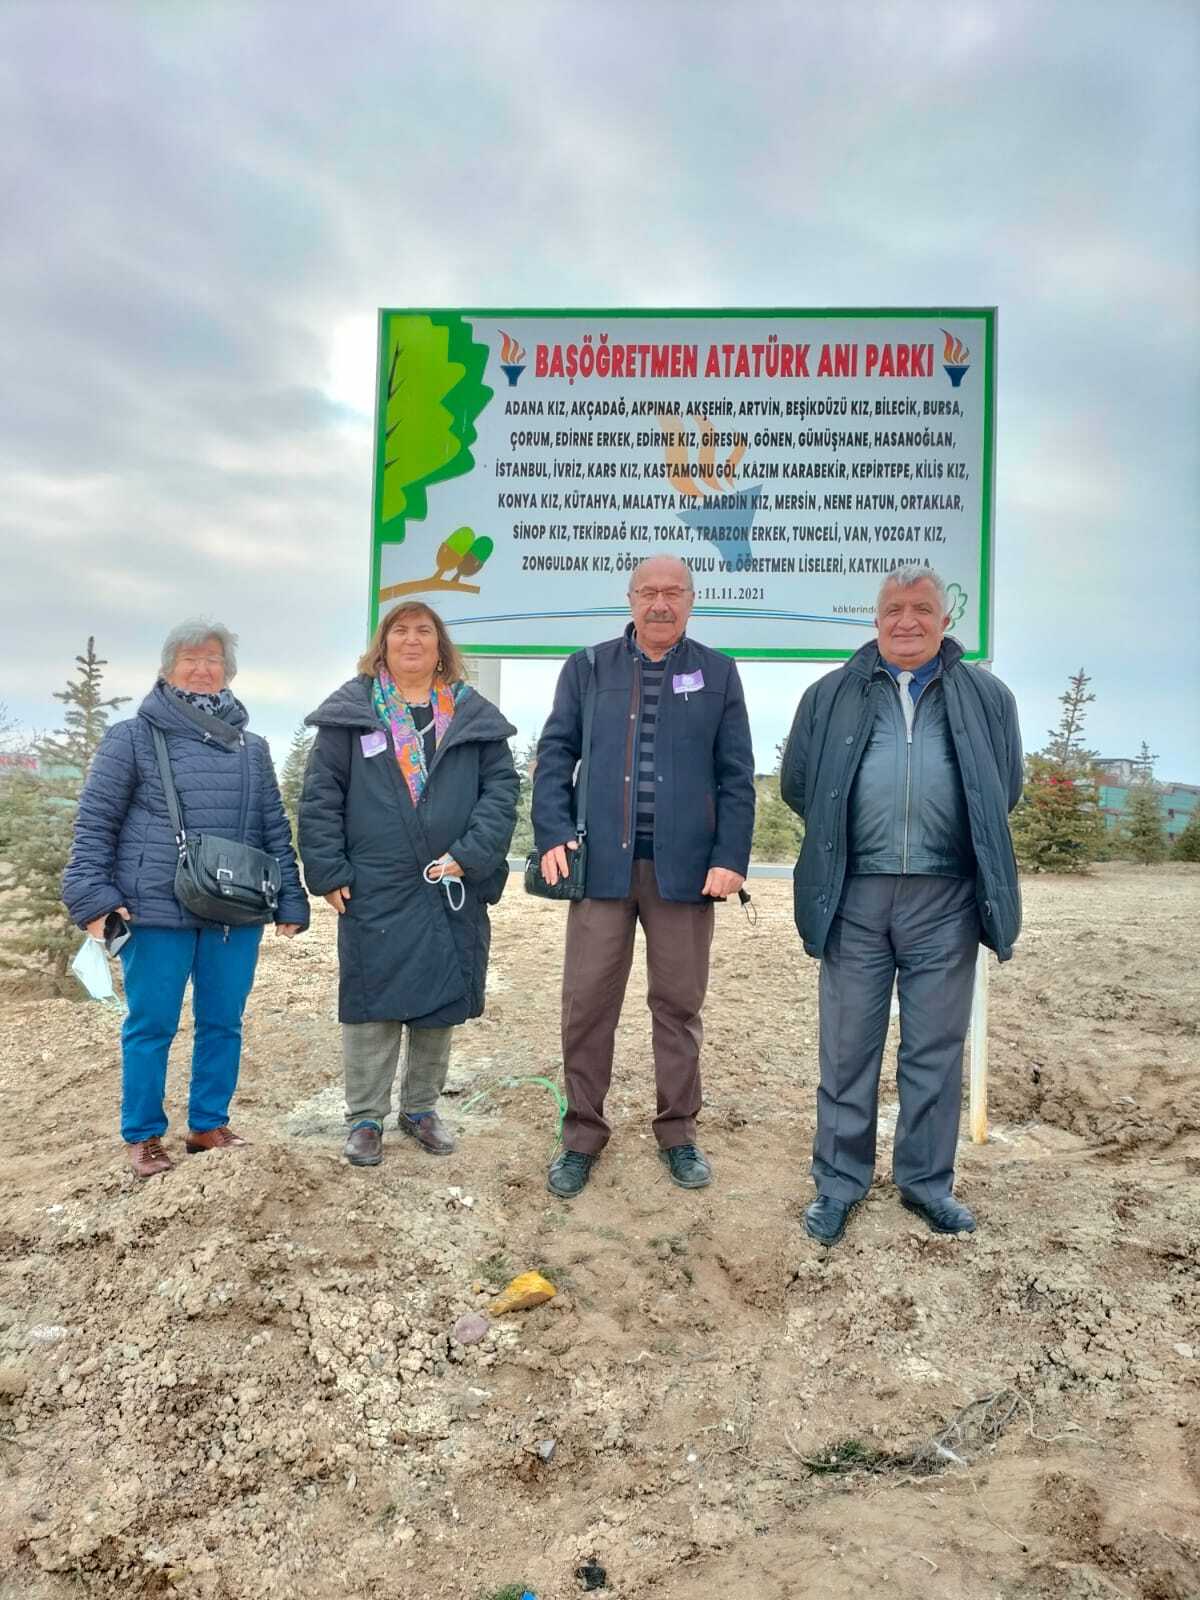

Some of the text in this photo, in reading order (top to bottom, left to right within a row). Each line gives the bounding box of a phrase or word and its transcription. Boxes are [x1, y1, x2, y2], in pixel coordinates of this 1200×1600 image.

[535, 333, 935, 386] BAŞÖĞRETMEN ATATÜRK ANI PARKI
[504, 396, 964, 421] ADANA KIZ, AKÇADAĞ, AKPINAR, AKŞEHİR, ARTVİN, BEŞİKDÜZÜ KIZ, BİLECİK, BURSA,
[510, 427, 957, 452] ÇORUM, EDİRNE ERKEK, EDİRNE KIZ, GİRESUN, GÖNEN, GÜMÜŞHANE, HASANOĞLAN,
[495, 458, 552, 480] İSTANBUL,
[553, 458, 586, 480] İVRİZ,
[587, 462, 617, 478] KARS
[619, 462, 642, 481] KIZ,
[643, 463, 714, 479] KASTAMONU
[715, 459, 741, 481] GÖL,
[782, 459, 850, 481] KARABEKİR,
[851, 459, 914, 481] KEPİRTEPE,
[915, 459, 944, 479] KİLİS
[946, 462, 970, 481] KIZ,
[497, 492, 538, 509] KONYA
[540, 492, 563, 511] KIZ,
[563, 490, 621, 511] KÜTAHYA,
[622, 494, 676, 510] MALATYA
[679, 494, 701, 511] KIZ,
[702, 490, 748, 510] MARDİN
[751, 494, 773, 512] KIZ,
[823, 494, 852, 510] NENE
[855, 494, 899, 513] HATUN,
[899, 494, 965, 513] ORTAKLAR,
[512, 520, 947, 544] SİNOP KIZ, TEKİRDAĞ KIZ, TOKAT, TRABZON ERKEK, TUNCELİ, VAN, YOZGAT KIZ,
[522, 556, 589, 572] ZONGULDAK
[591, 556, 615, 574] KIZ,
[718, 559, 732, 573] ve
[735, 553, 796, 573] ÖĞRETMEN
[798, 553, 847, 575] LİSELERİ,
